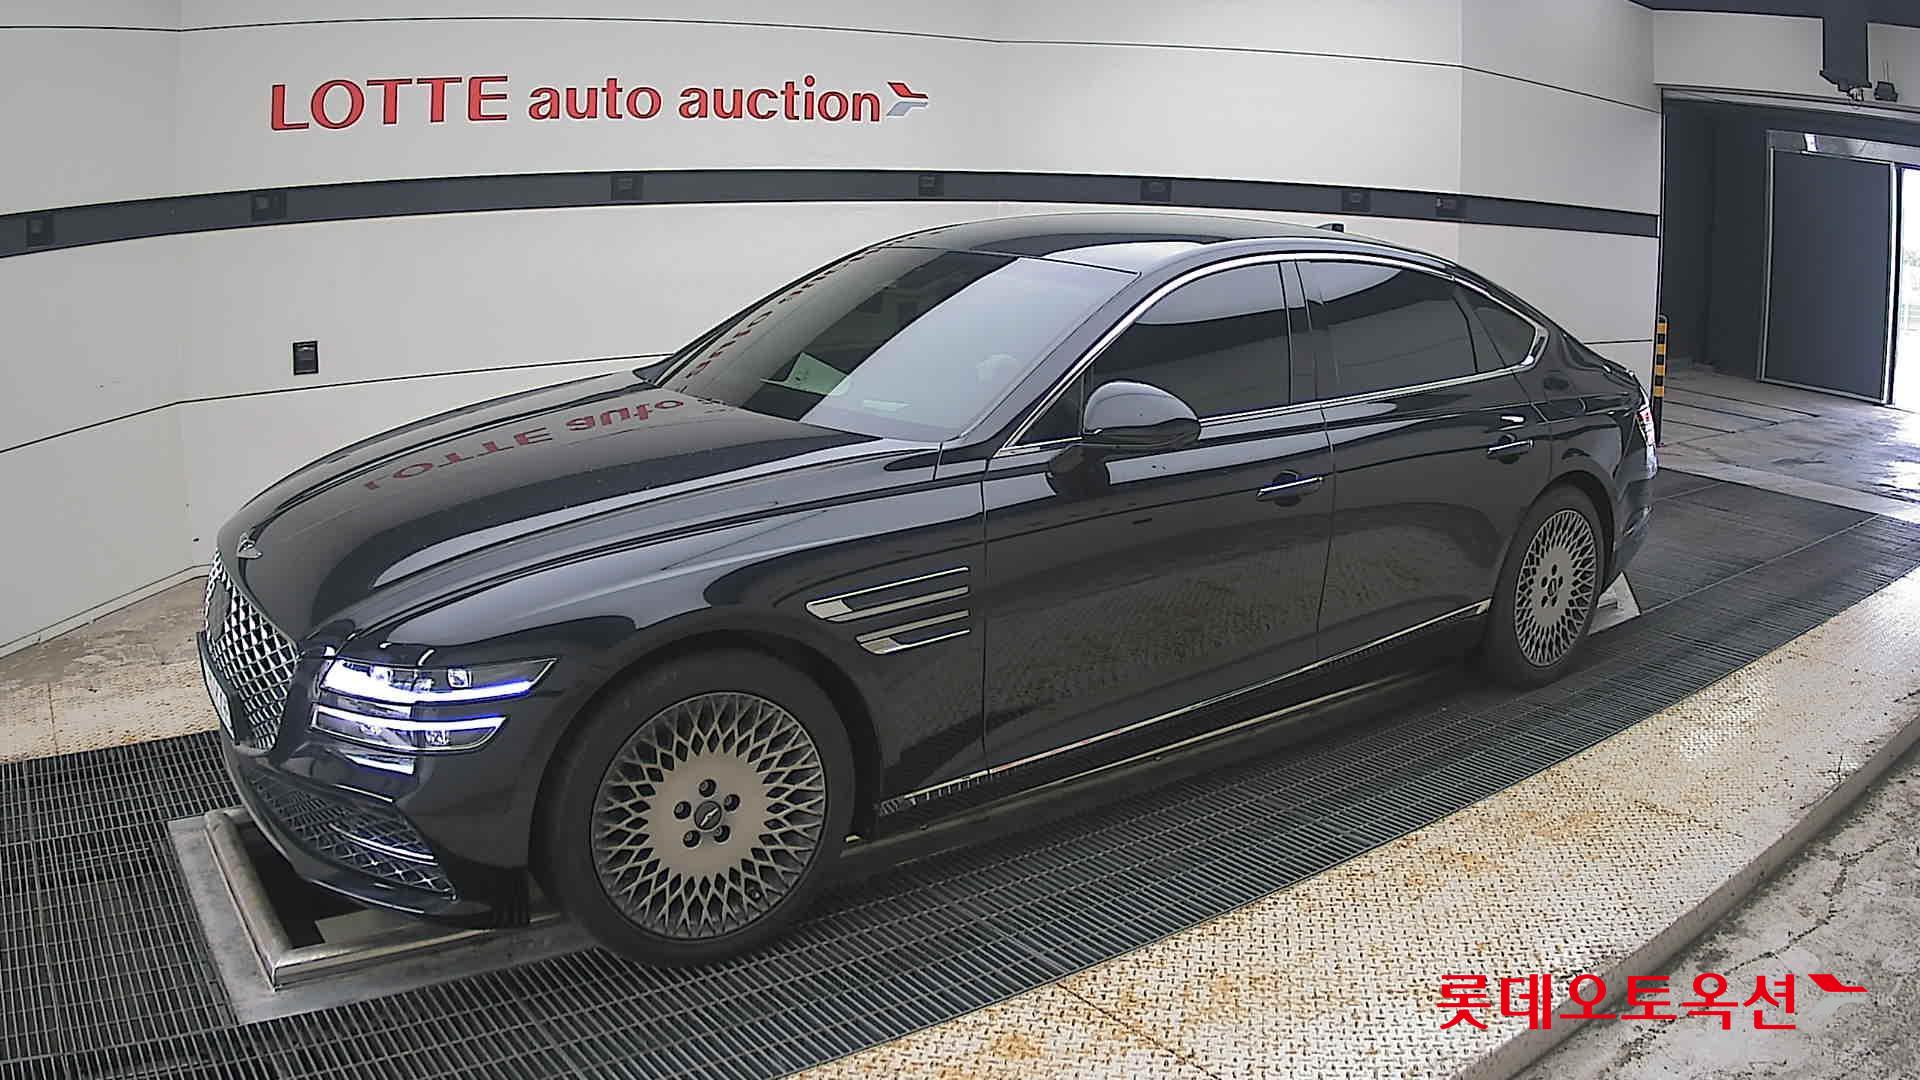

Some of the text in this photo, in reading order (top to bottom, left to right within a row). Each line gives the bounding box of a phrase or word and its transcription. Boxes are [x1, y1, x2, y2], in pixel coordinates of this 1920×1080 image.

[271, 75, 881, 130] LOTTE auto auction
